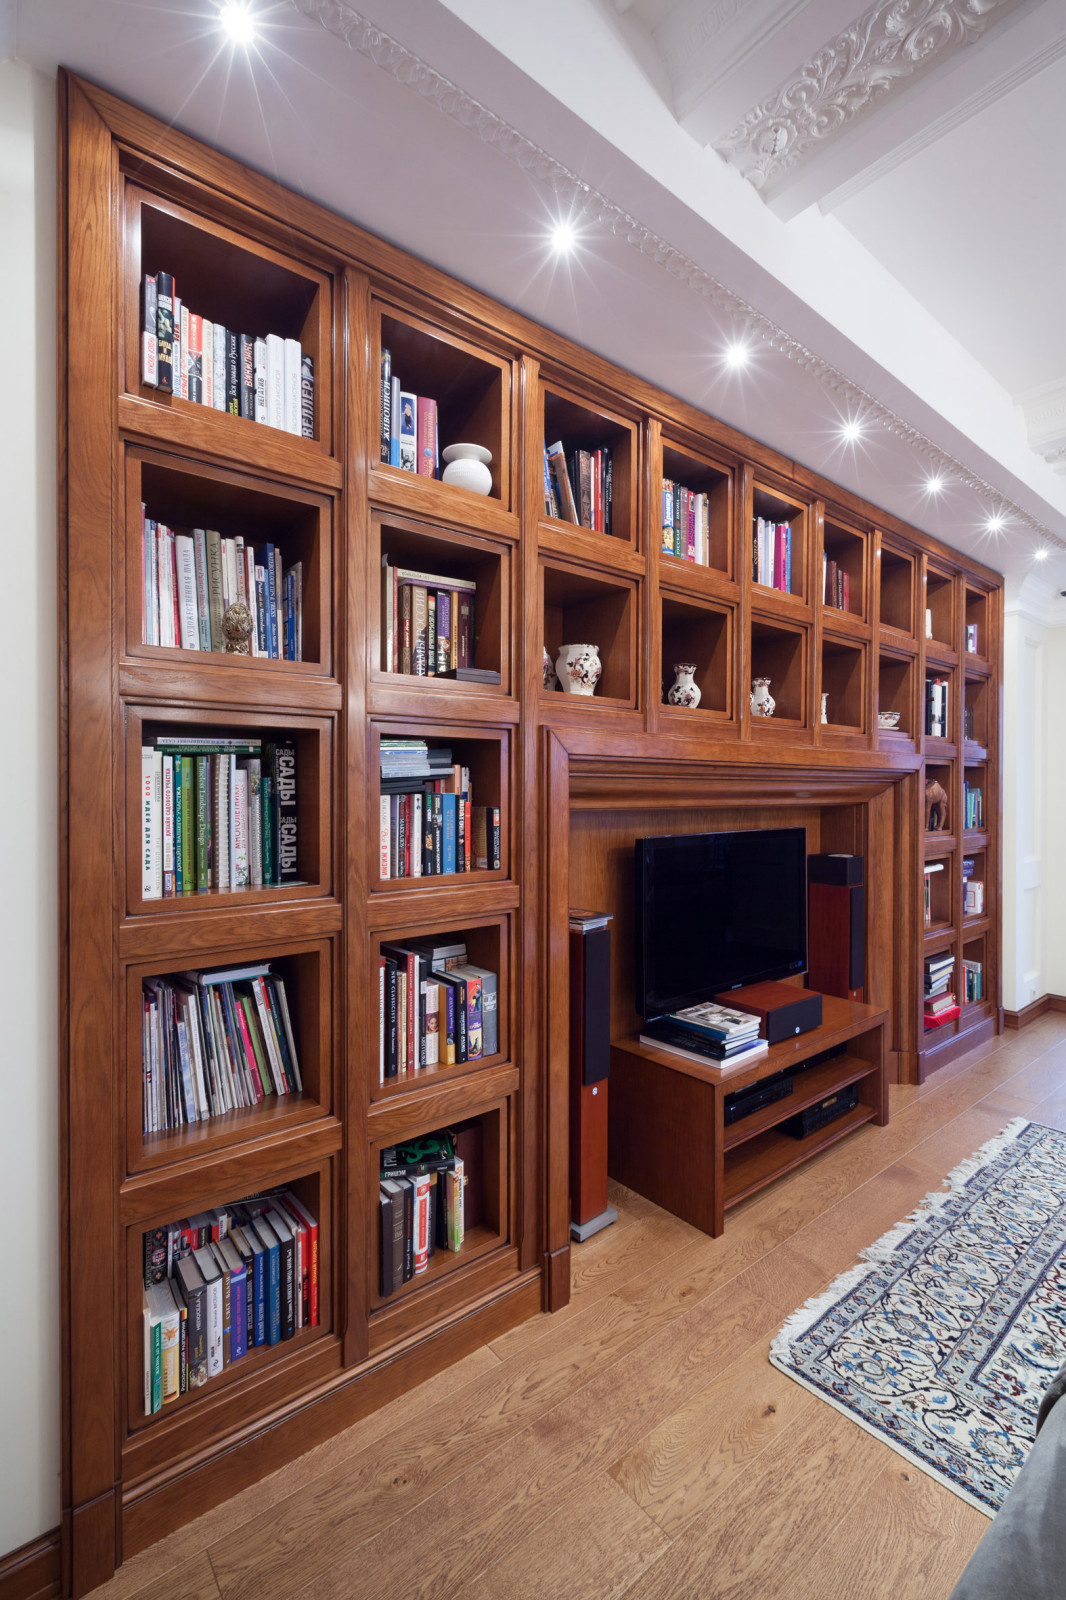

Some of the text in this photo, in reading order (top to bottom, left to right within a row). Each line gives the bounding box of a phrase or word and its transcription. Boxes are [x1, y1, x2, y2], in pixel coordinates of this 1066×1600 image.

[228, 334, 239, 360] Русских
[231, 366, 239, 385] правда
[243, 338, 253, 387] ВИКИЛИКС
[228, 385, 238, 396] Вся
[257, 377, 265, 407] НЕГАТИВ
[302, 379, 314, 439] ВЕЛЛЕР
[197, 542, 205, 571] Watercolour
[210, 542, 220, 595] РИСУНКА
[183, 549, 195, 638] ХУДОЖЕСТВЕННАЯ ШКОЛА
[199, 593, 207, 618] Handbook
[415, 589, 425, 677] ХРАМЫ РОССИИ
[275, 748, 295, 756] САДЫ
[278, 756, 297, 806] САДЫ
[198, 790, 206, 822] Landscape
[198, 823, 206, 846] Design
[280, 823, 298, 873] САДЫ
[384, 1170, 407, 1178] ГРИШЭМ
